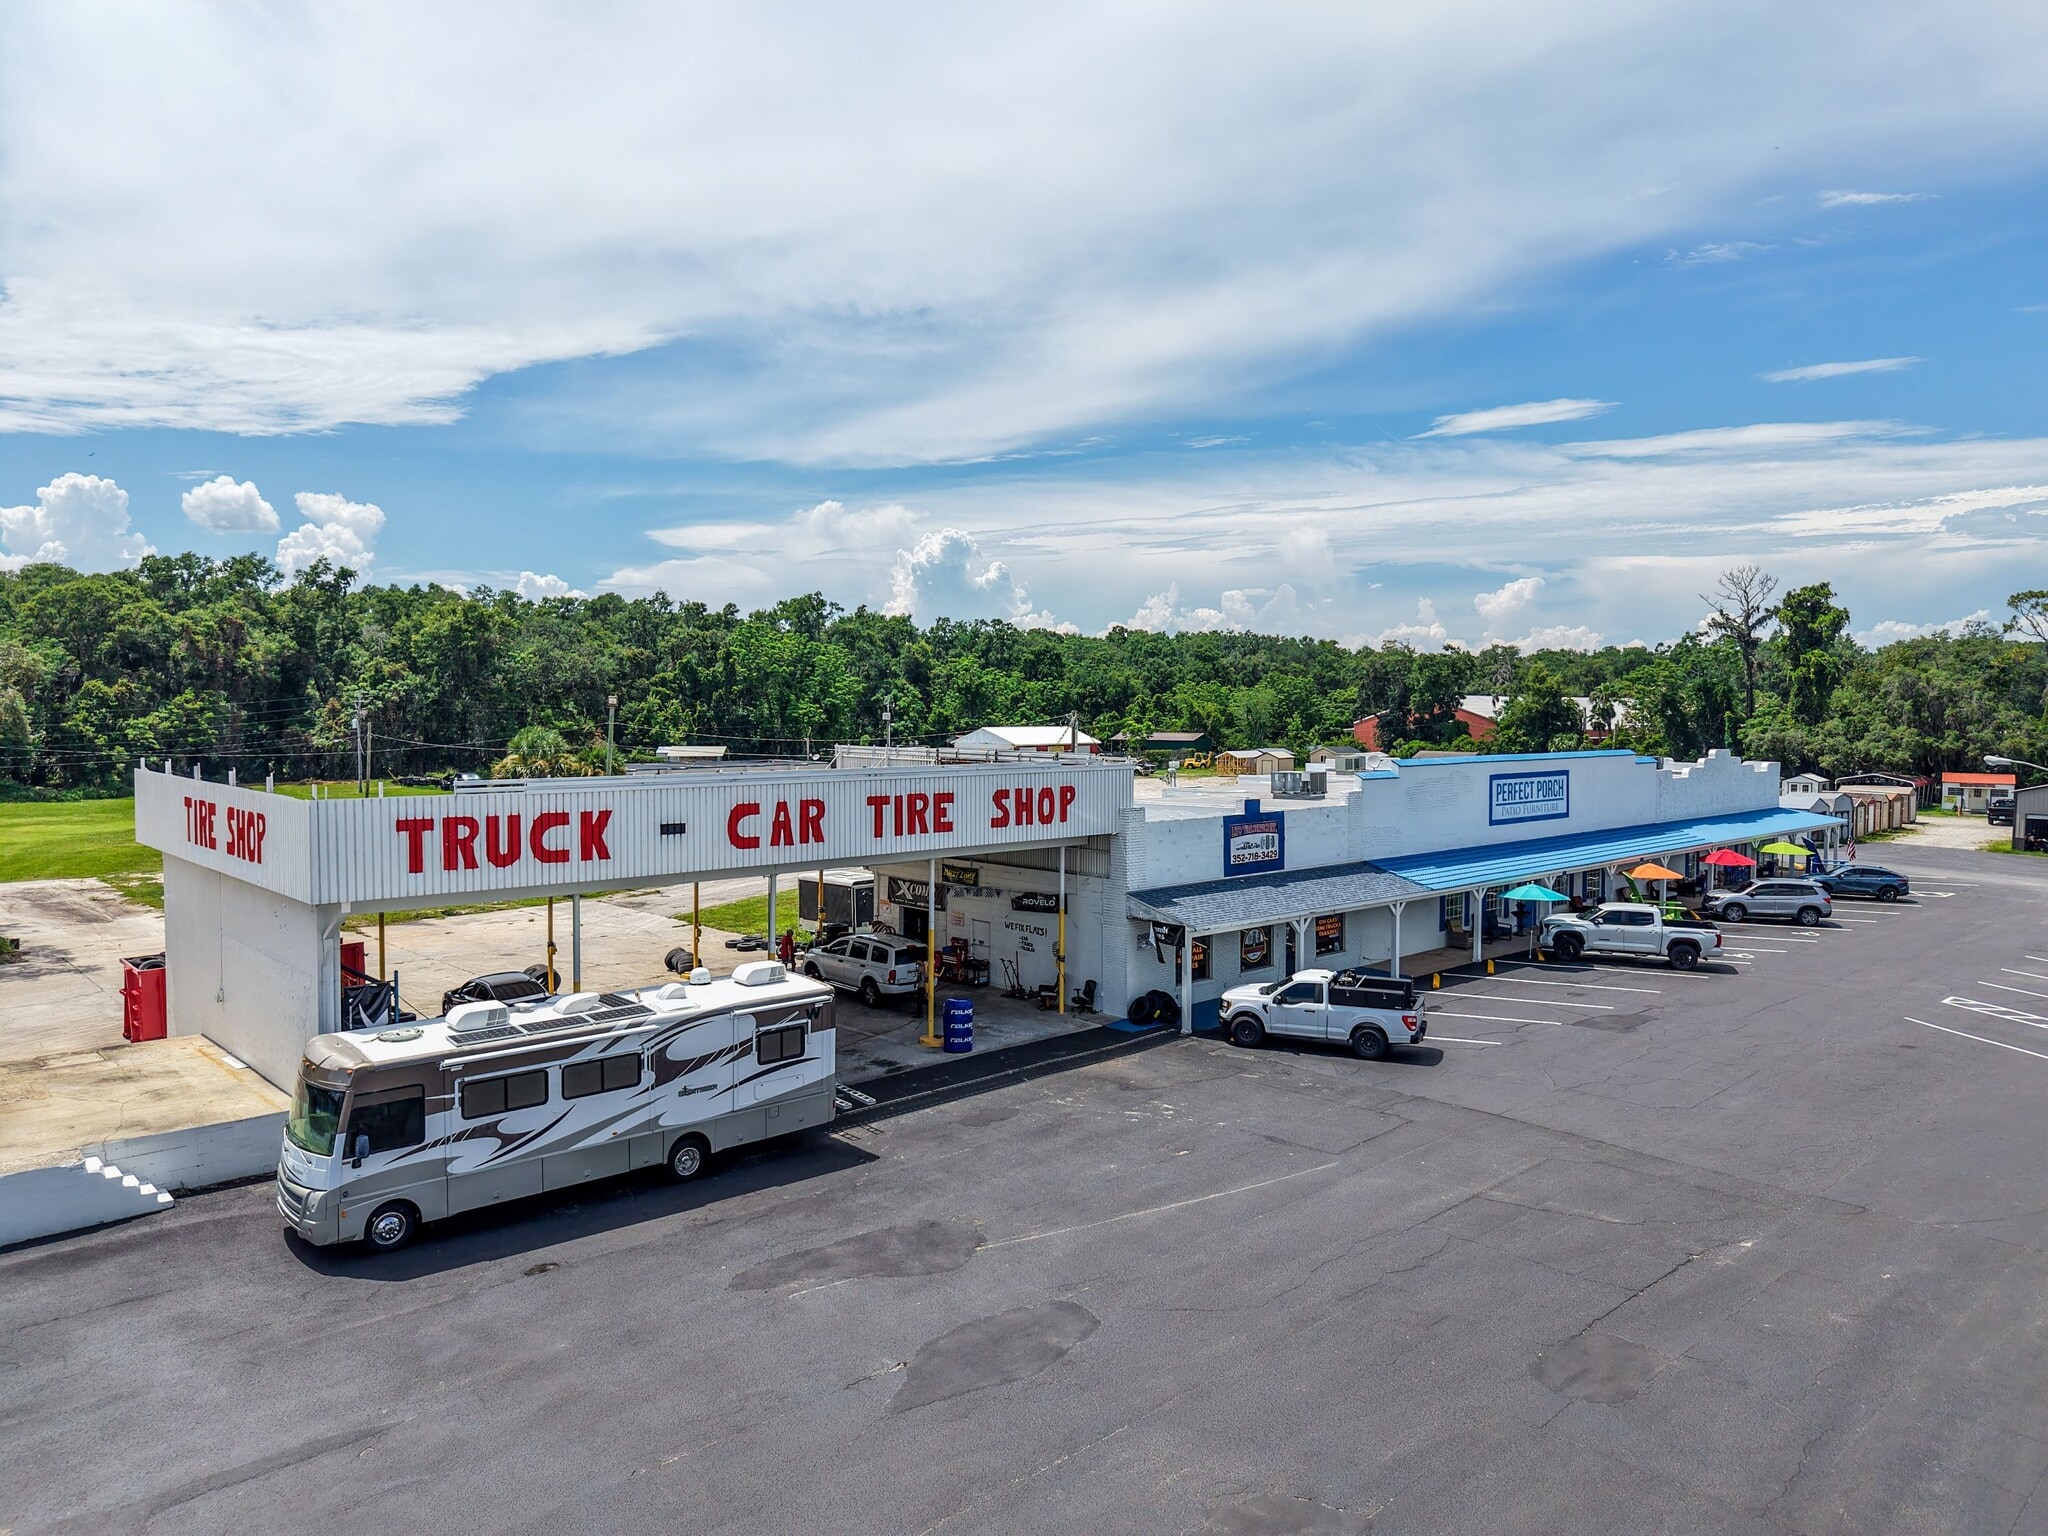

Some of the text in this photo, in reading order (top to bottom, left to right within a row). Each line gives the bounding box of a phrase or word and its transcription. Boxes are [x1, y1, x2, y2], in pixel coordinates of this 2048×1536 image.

[1496, 779, 1564, 802] PERFECT PORCH
[1501, 802, 1559, 817] PATIO FURNITURE
[184, 796, 266, 864] TIRE SHOP
[395, 809, 613, 874] TRUCK
[727, 798, 826, 850] CAR
[866, 791, 955, 839] TIRE
[990, 785, 1076, 829] SHOP
[1232, 849, 1278, 863] 352-718-3429
[895, 880, 934, 900] XCOM
[1022, 898, 1056, 907] ROVELO
[1004, 921, 1015, 931] WE
[1015, 922, 1025, 933] FIX
